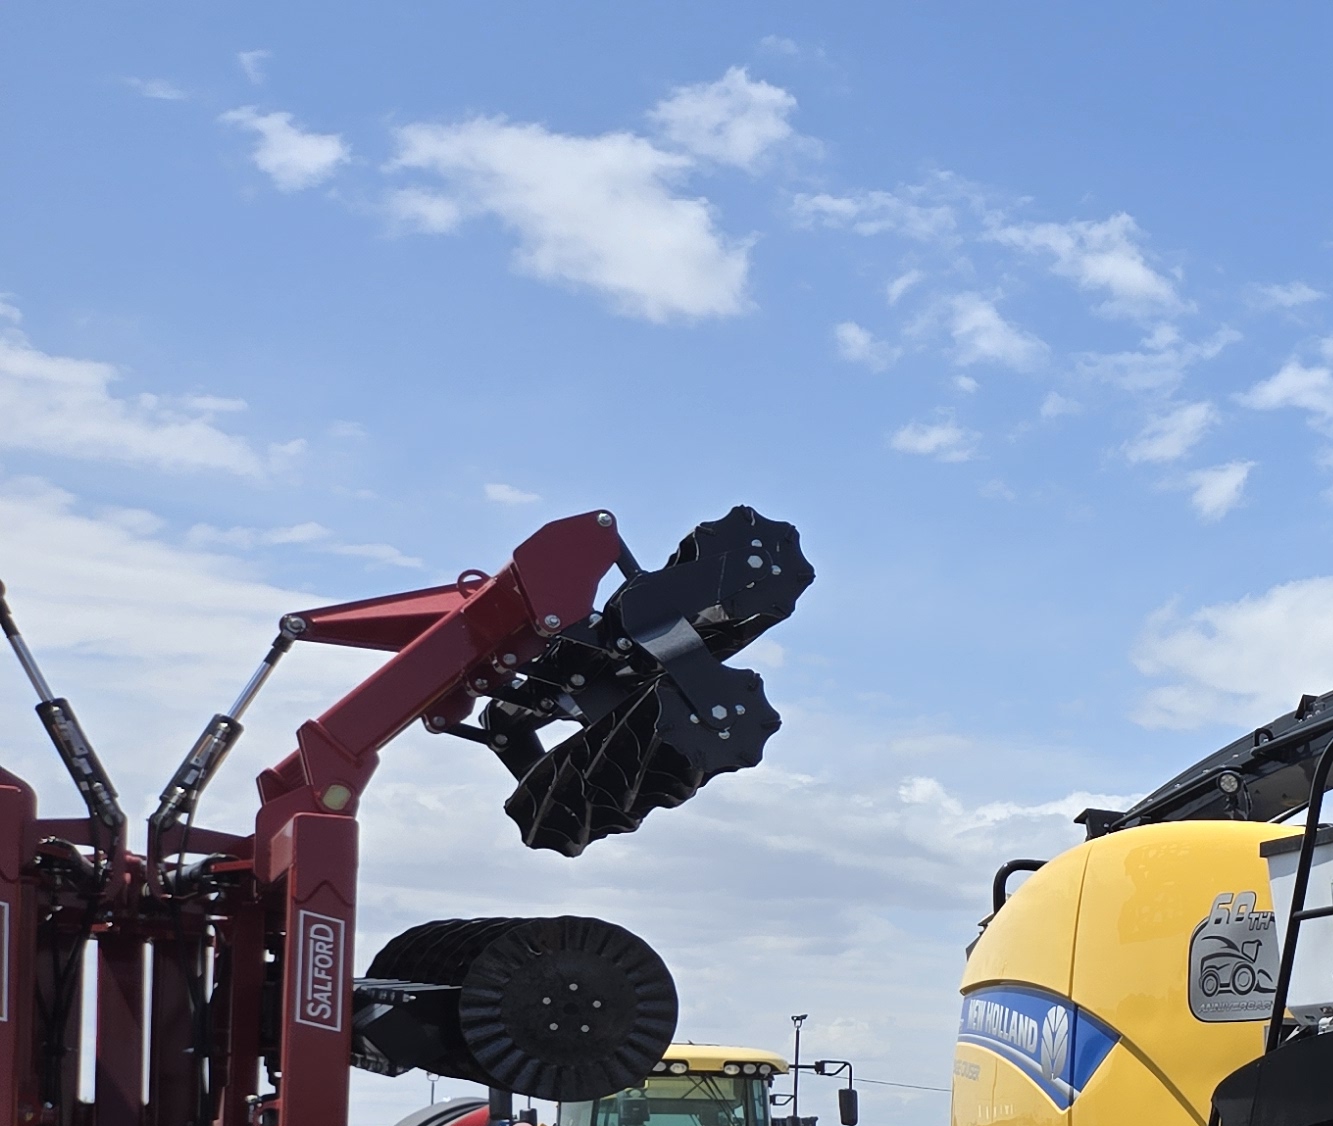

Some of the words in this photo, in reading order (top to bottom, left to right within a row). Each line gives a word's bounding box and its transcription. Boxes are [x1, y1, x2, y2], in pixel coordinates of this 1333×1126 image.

[306, 923, 334, 1019] SALFORD
[967, 999, 987, 1032] NEW
[985, 1001, 1038, 1054] HOLLAND
